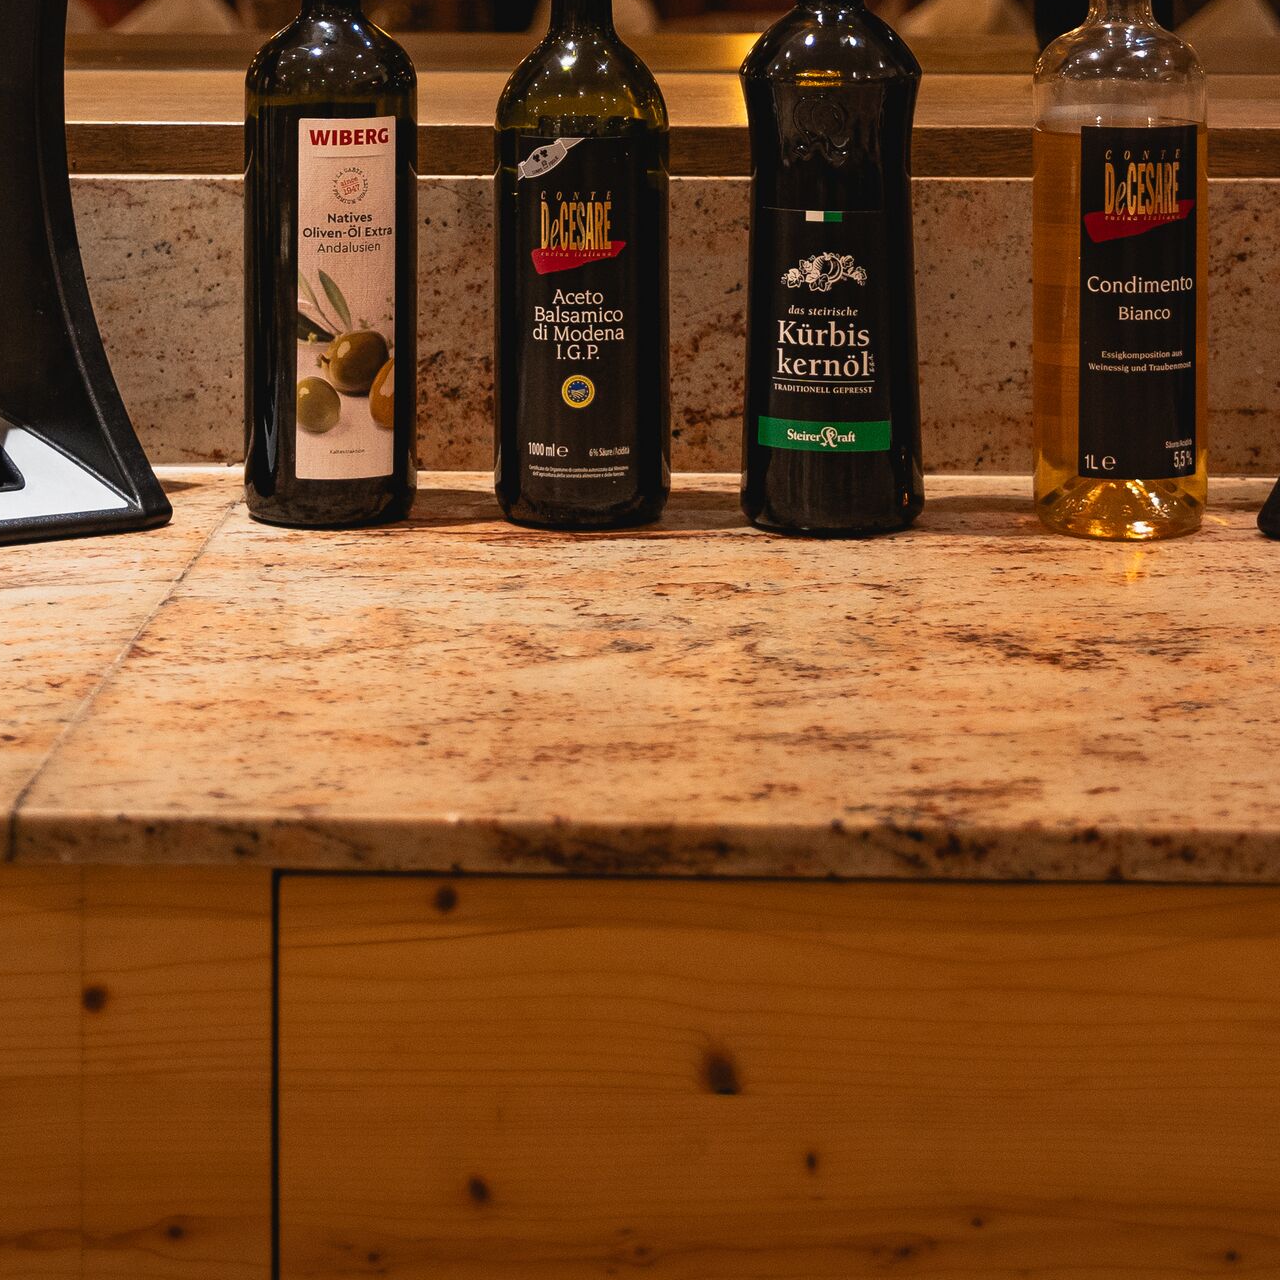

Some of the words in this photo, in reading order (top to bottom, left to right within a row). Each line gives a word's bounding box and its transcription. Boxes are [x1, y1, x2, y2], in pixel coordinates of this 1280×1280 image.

[309, 128, 389, 146] WIBERG
[1105, 149, 1181, 160] CONTE
[540, 190, 611, 201] CONTE
[327, 212, 372, 223] Natives
[302, 225, 361, 238] Oliven-Öl
[365, 226, 392, 237] Extra
[317, 242, 381, 253] Andalusien
[1087, 275, 1193, 294] Condimento
[552, 288, 604, 305] Aceto
[534, 305, 623, 323] Balsamico
[788, 304, 805, 315] das
[807, 306, 859, 317] steirische
[1118, 306, 1171, 321] Bianco
[532, 323, 548, 340] di
[553, 324, 625, 342] Modena
[777, 320, 870, 347] Kürbis
[556, 343, 600, 360] I.G.P.
[1101, 350, 1170, 360] Essigkomposition
[776, 348, 870, 376] kernöl
[1088, 362, 1129, 374] Weinessig
[1131, 364, 1147, 372] und
[1148, 361, 1192, 372] Traubenmost
[774, 383, 830, 394] TRADITIONELL
[832, 386, 873, 394] GEPRESST
[528, 442, 545, 456] 1000
[545, 443, 555, 457] ml
